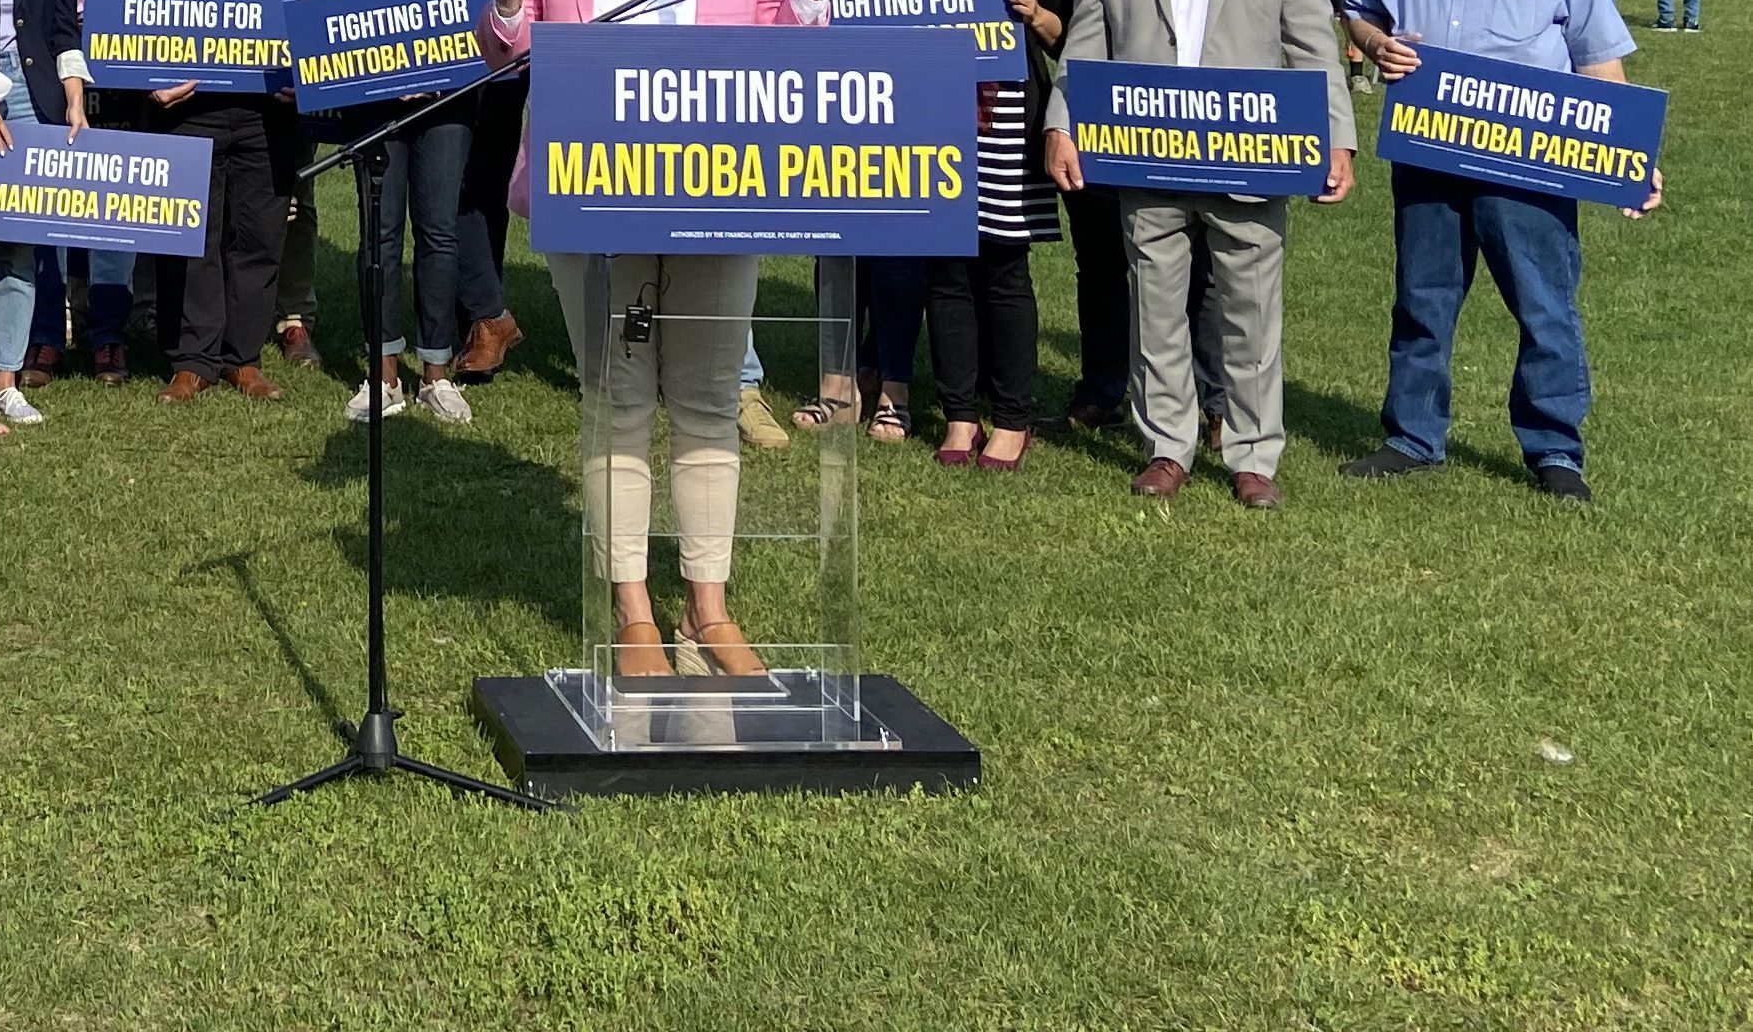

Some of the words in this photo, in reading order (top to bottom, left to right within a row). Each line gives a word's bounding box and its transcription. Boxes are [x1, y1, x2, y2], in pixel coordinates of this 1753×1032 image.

[124, 0, 218, 28] FIGHTING
[223, 2, 262, 29] FOR
[327, 3, 424, 43] FIGHTING
[90, 34, 197, 63] MANITOBA
[203, 38, 292, 67] PARENTS
[299, 45, 410, 85] MANITOBA
[413, 30, 482, 66] PAREN
[616, 69, 804, 124] FIGHTING
[817, 71, 895, 125] FOR
[1113, 86, 1223, 121] FIGHTING
[1228, 92, 1277, 124] FOR
[1437, 71, 1556, 123] FIGHTING
[1560, 96, 1612, 135] FOR
[1077, 123, 1202, 160] MANITOBA
[1208, 131, 1321, 166] PARENTS
[1391, 103, 1522, 157] MANITOBA
[1529, 132, 1649, 182] PARENTS
[25, 148, 124, 183] FIGHTING
[128, 156, 170, 187] FOR
[549, 142, 766, 197] MANITOBA
[780, 145, 963, 200] PARENTS
[105, 193, 202, 228] PARENTS
